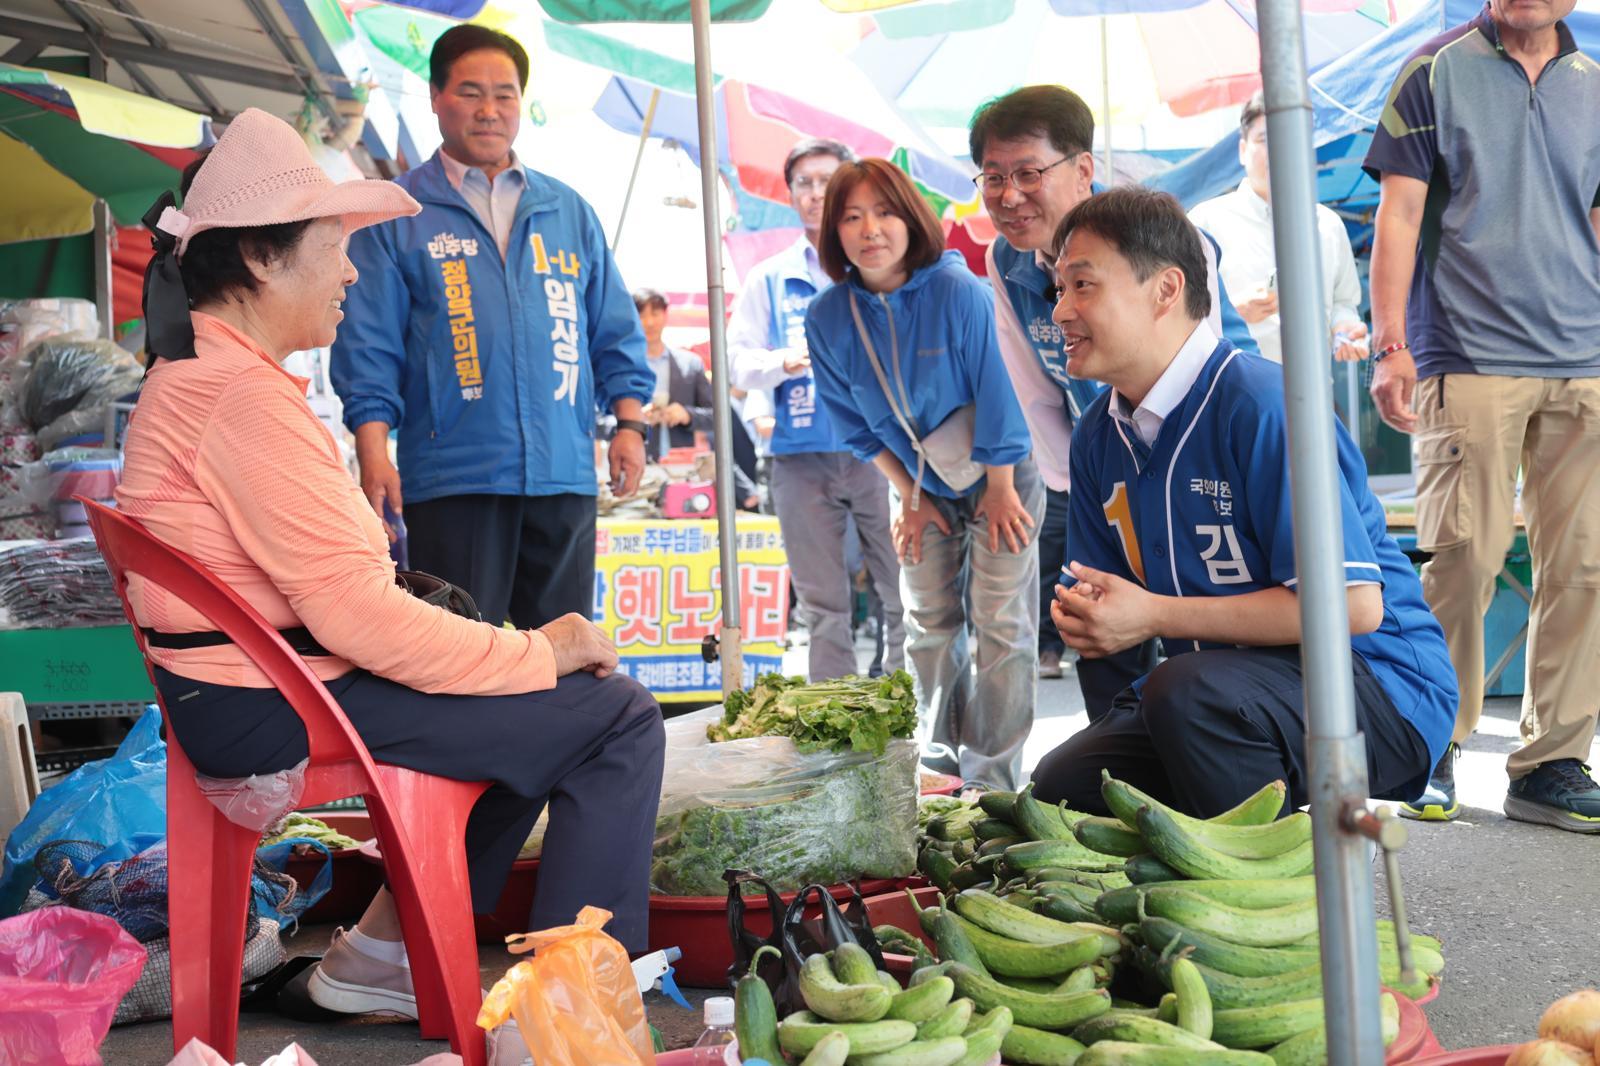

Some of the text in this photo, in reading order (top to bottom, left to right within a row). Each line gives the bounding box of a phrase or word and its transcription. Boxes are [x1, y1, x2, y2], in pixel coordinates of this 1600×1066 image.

[427, 238, 478, 259] 민주당
[544, 278, 580, 406] 임상기
[1028, 325, 1061, 343] 민주당
[1103, 481, 1148, 589] 1
[1195, 524, 1253, 585] 김
[616, 568, 660, 644] 햇
